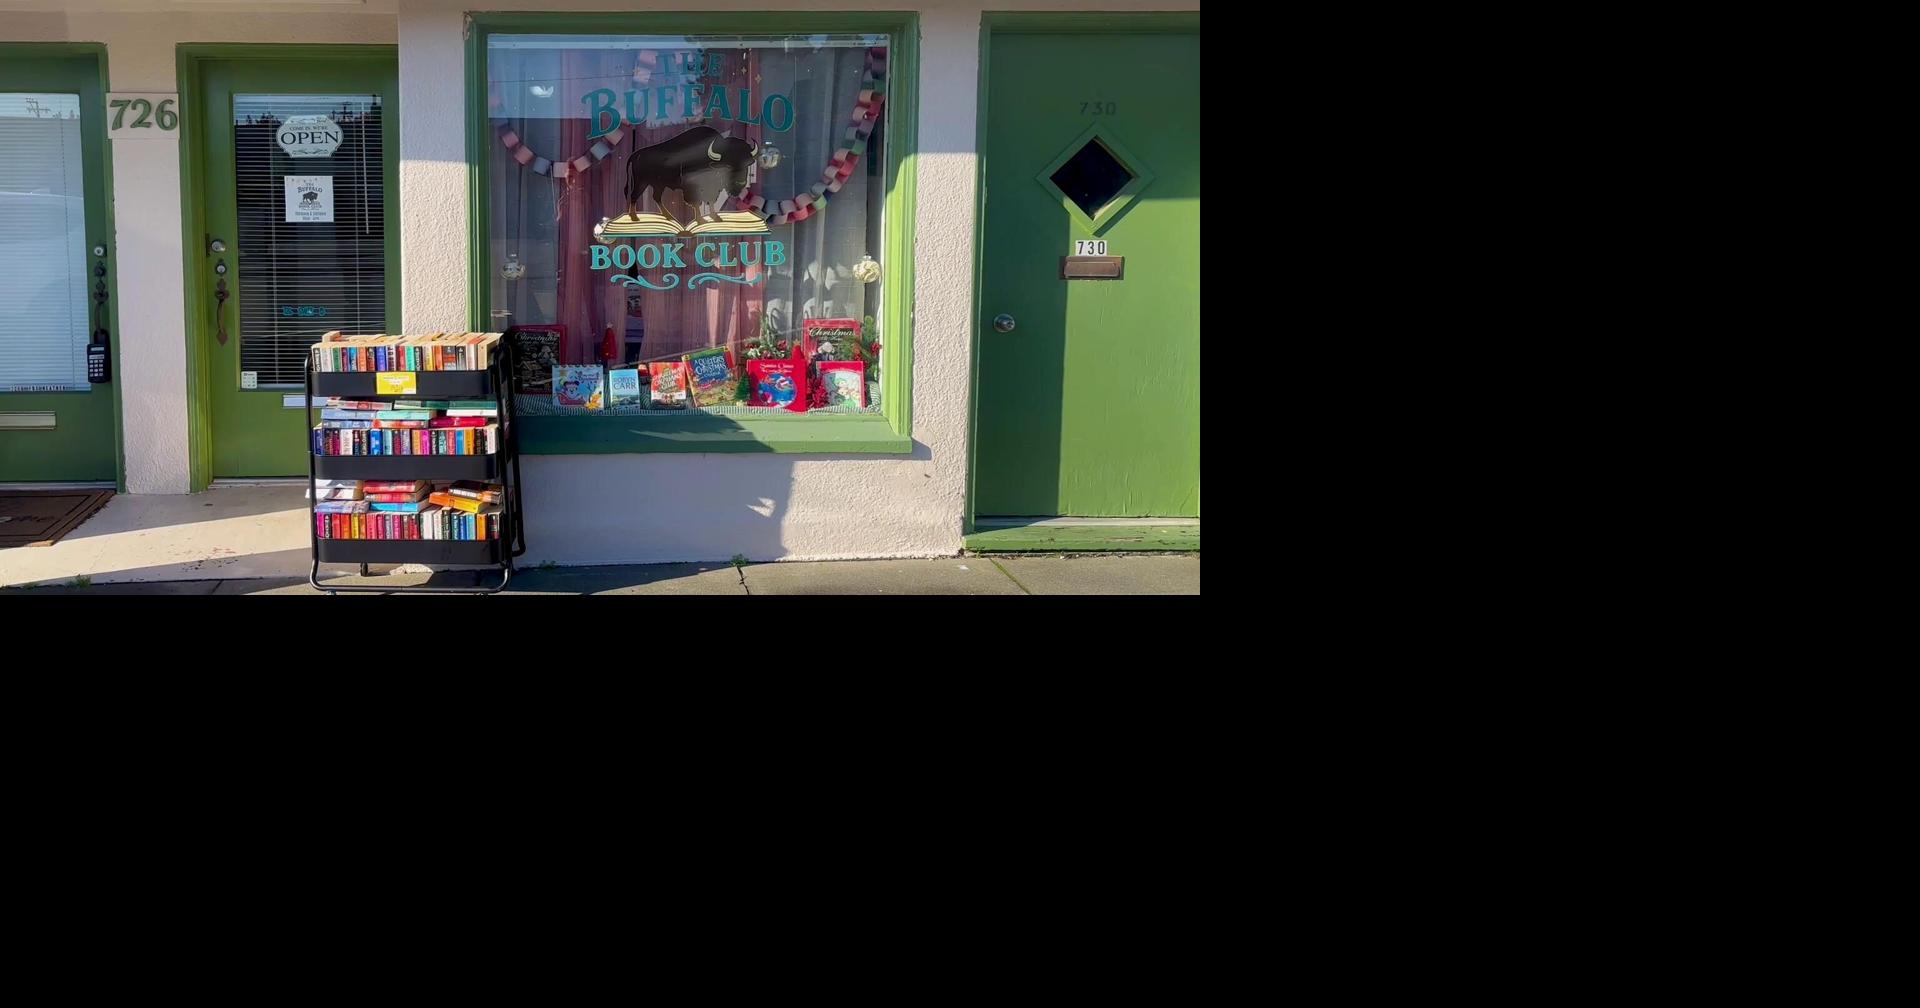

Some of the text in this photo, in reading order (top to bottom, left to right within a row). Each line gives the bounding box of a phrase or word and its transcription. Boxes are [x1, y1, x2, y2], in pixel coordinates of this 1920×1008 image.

[655, 52, 726, 77] THE
[110, 98, 178, 131] 726
[581, 83, 795, 140] BUFFALO
[1080, 101, 1116, 116] 730
[281, 131, 339, 145] OPEN
[589, 240, 786, 270] BOOK CLUB
[1077, 241, 1105, 255] 730
[613, 382, 637, 390] CARR
